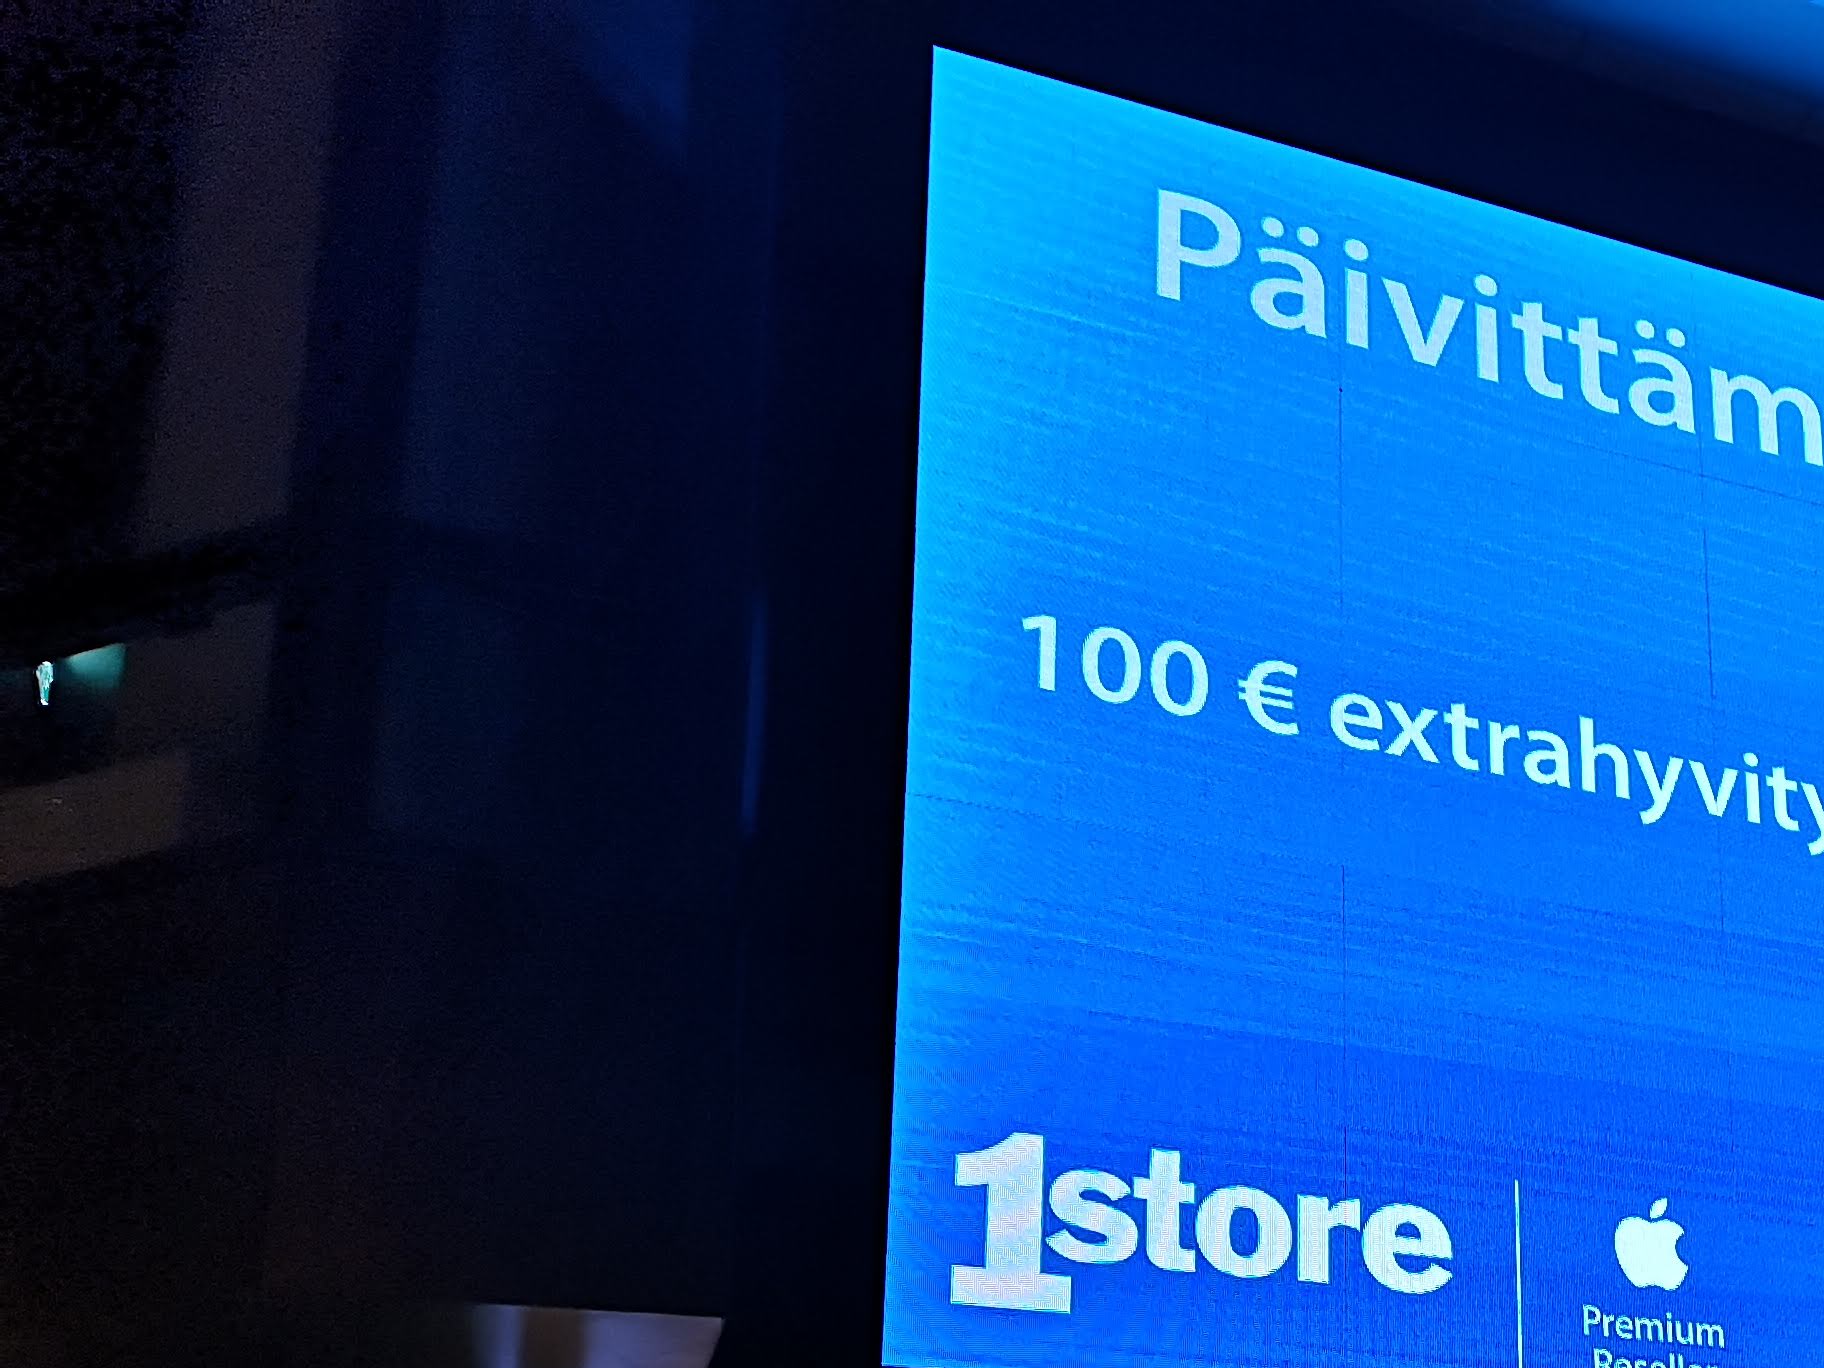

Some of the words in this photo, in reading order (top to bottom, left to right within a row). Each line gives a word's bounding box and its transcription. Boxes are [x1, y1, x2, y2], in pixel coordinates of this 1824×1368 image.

[1021, 614, 1210, 717] 100
[1237, 659, 1300, 736] €
[949, 1131, 1455, 1314] 1store
[1581, 1303, 1726, 1350] Premium
